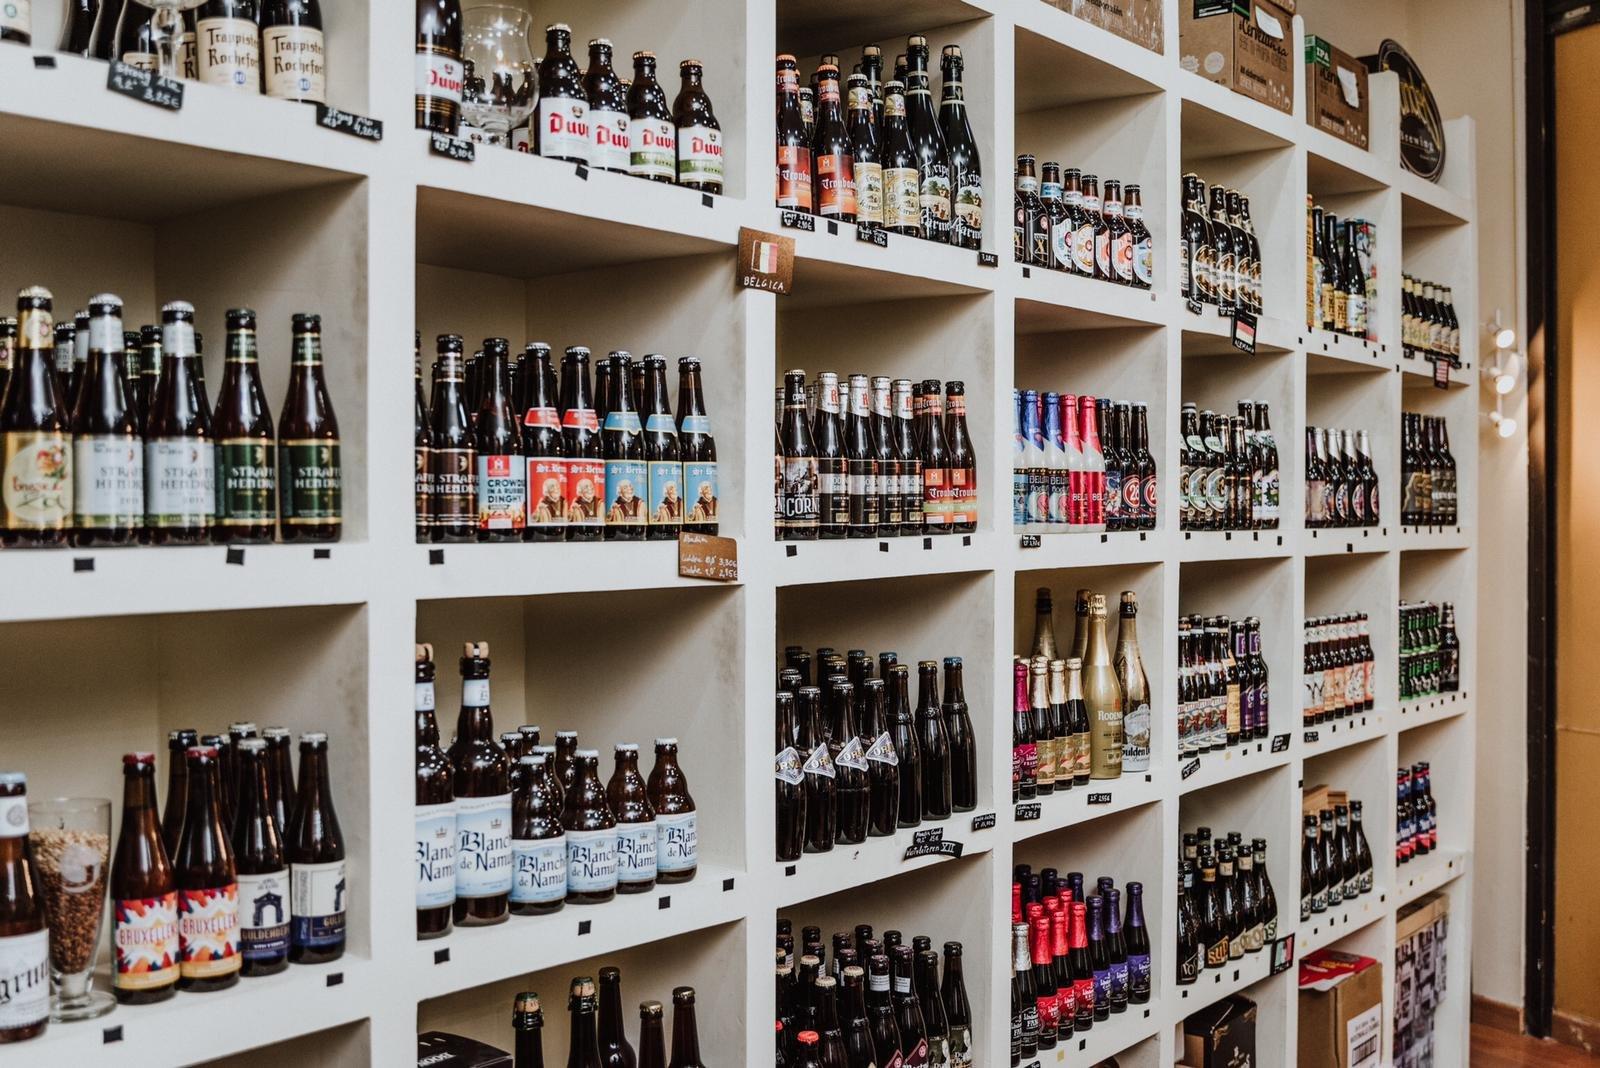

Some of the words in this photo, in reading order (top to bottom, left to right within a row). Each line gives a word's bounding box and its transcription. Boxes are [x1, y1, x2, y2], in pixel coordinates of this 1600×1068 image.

[667, 847, 677, 857] de
[941, 841, 956, 854] XII
[460, 856, 472, 870] de
[571, 866, 582, 877] de
[518, 875, 529, 887] de
